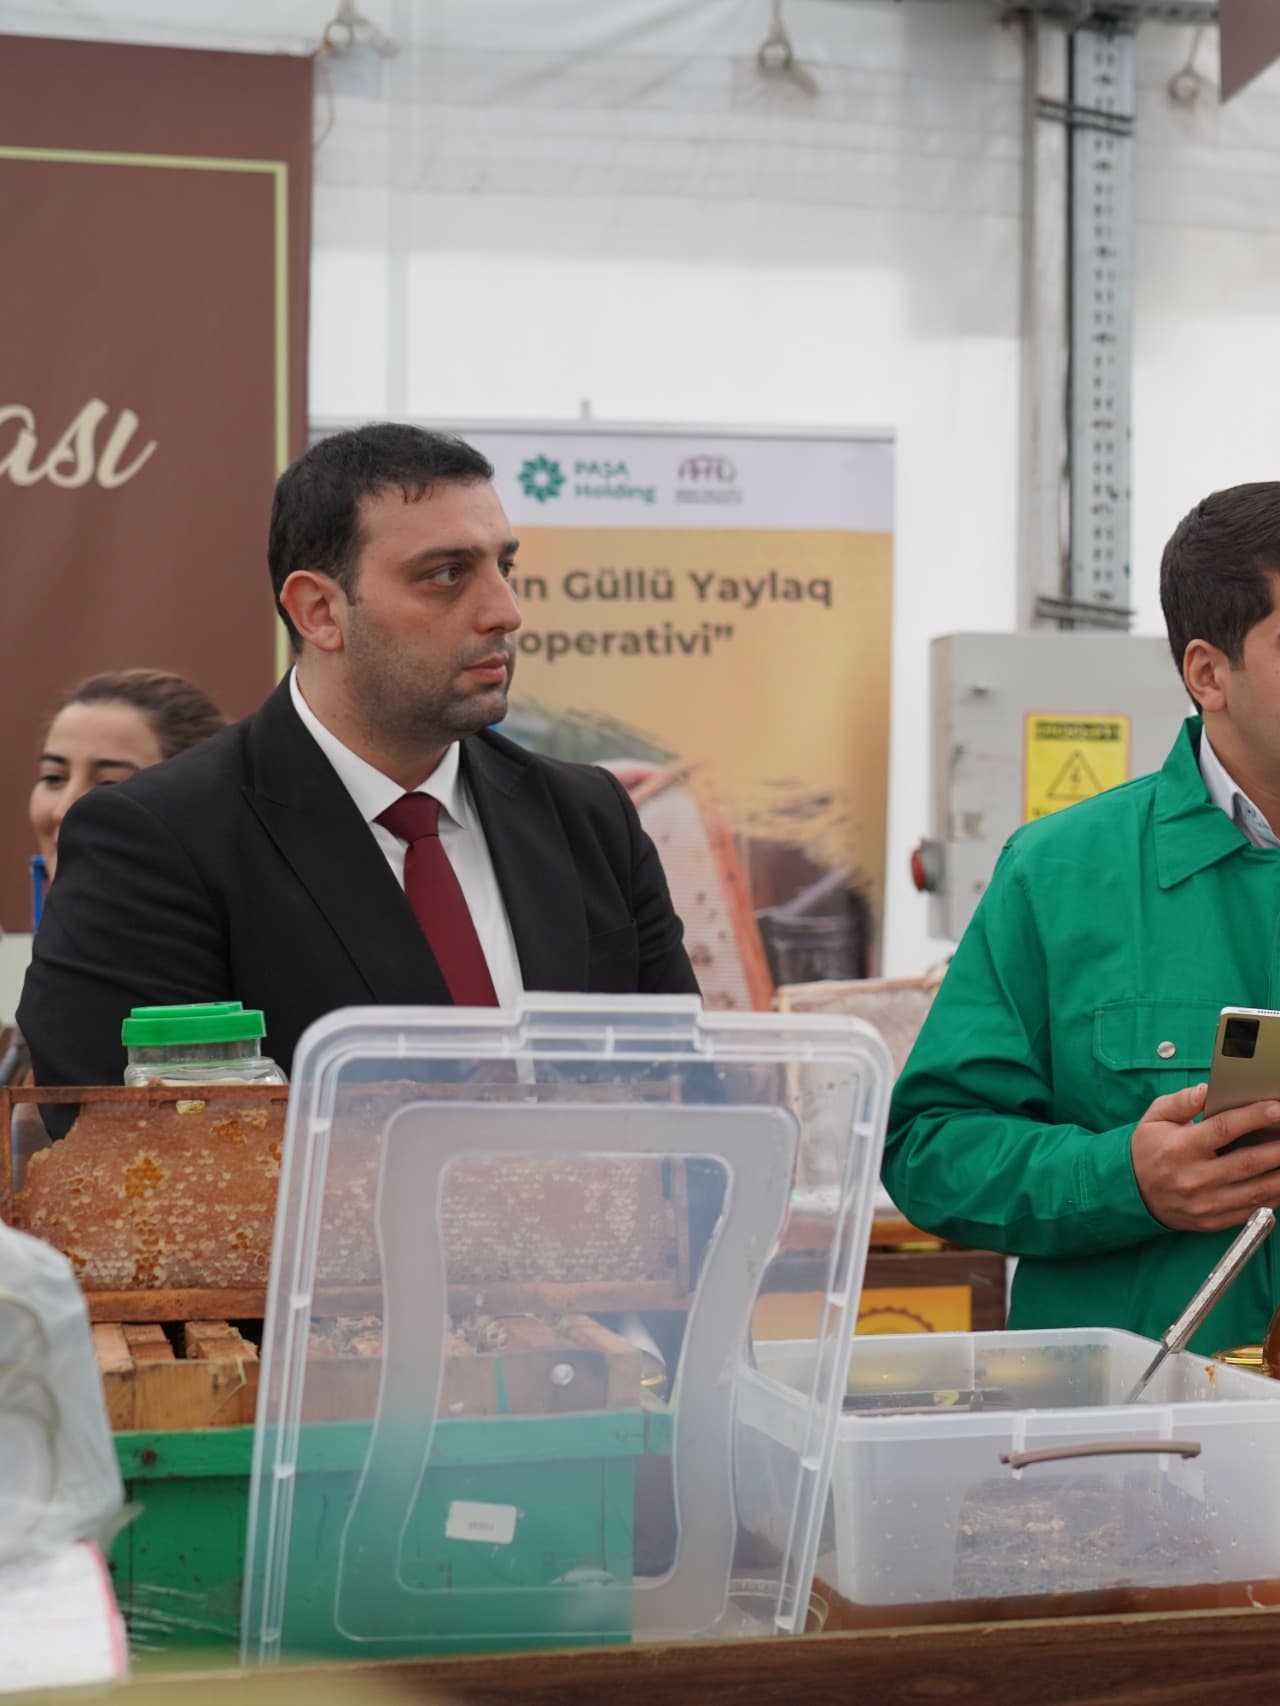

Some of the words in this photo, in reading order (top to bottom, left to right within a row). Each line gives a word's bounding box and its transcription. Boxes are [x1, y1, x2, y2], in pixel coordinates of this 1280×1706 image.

[0, 397, 157, 489] ası
[573, 460, 629, 477] PAŞA
[573, 484, 656, 505] Holding
[563, 567, 674, 600] Güllü
[689, 569, 832, 609] Yaylaq
[519, 622, 734, 664] operativi”
